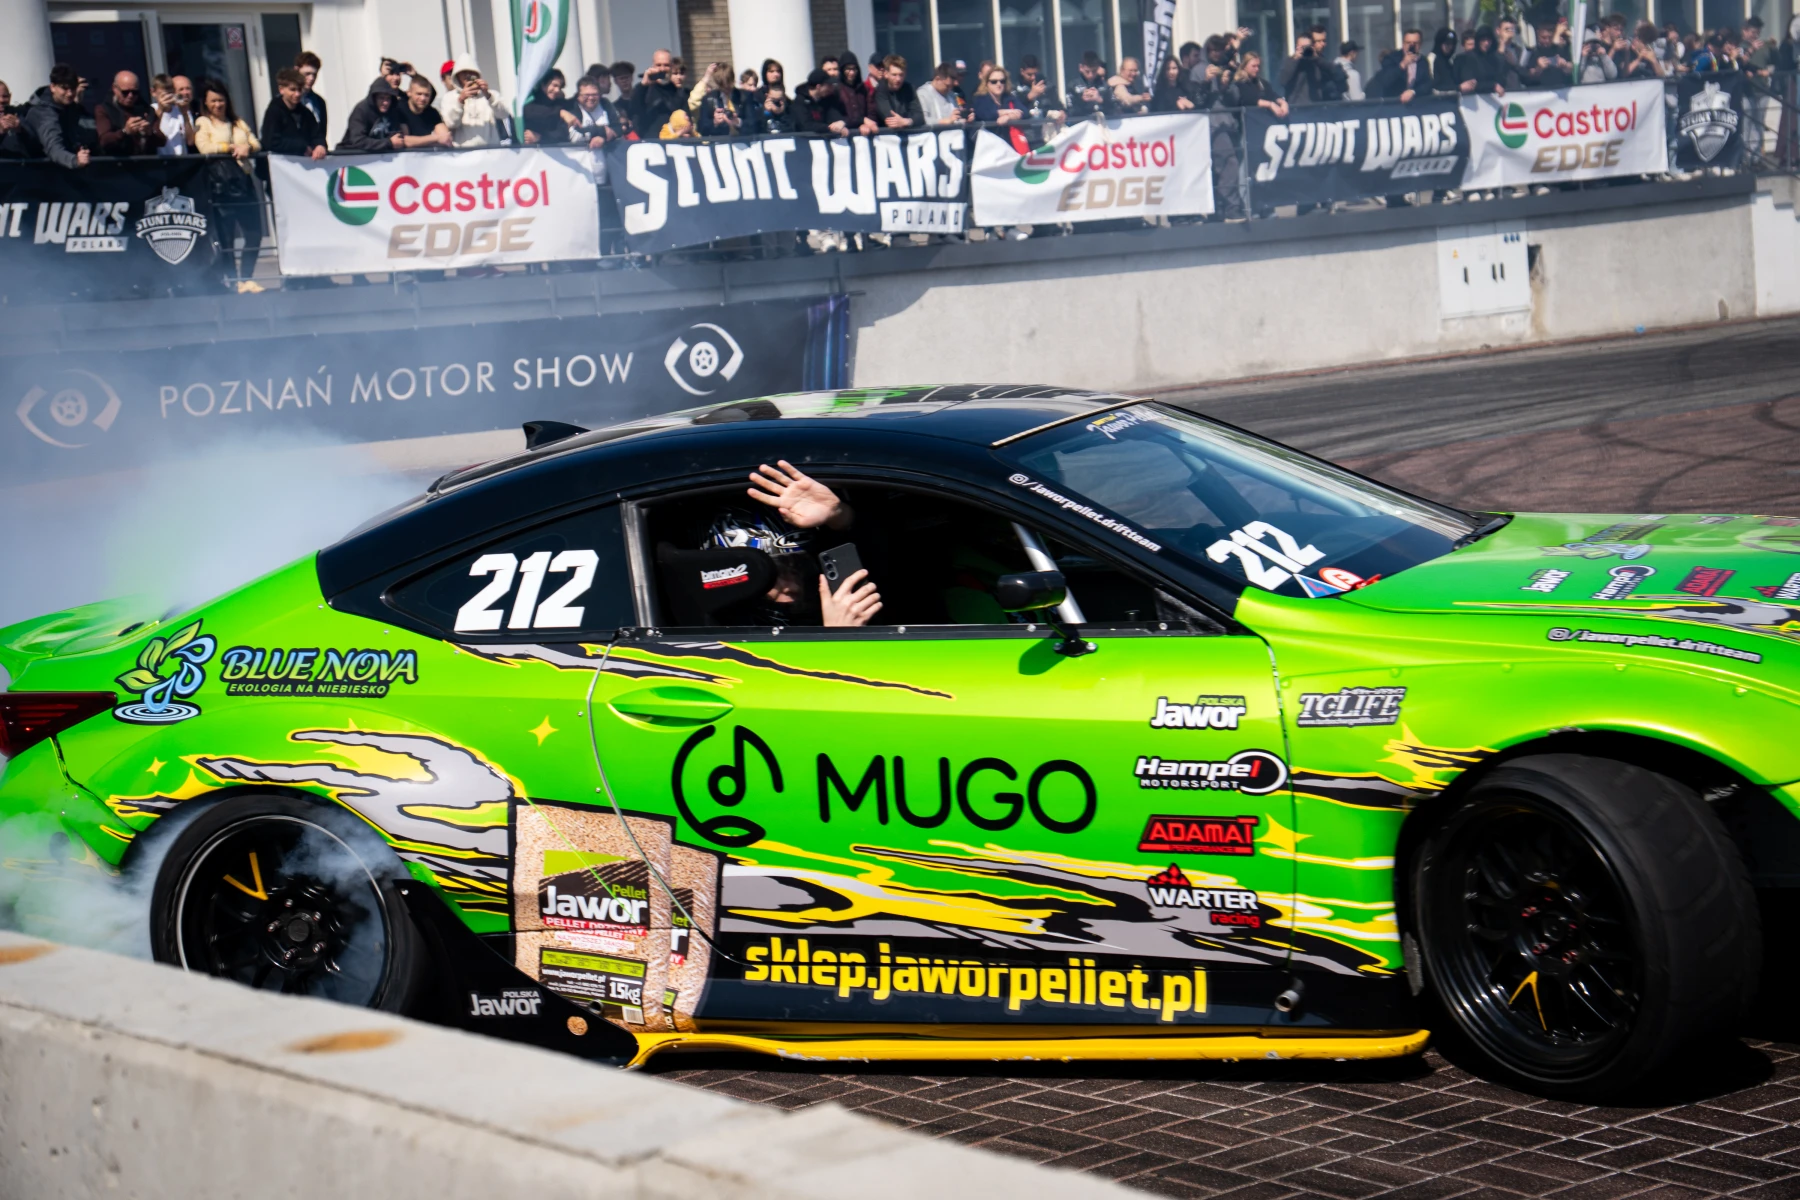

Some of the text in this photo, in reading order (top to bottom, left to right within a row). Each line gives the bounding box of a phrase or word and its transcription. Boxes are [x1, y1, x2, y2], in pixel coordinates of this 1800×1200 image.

[1534, 100, 1637, 139] Castrol
[1059, 135, 1175, 173] Castrol
[1255, 112, 1458, 182] STUNT WARS
[1531, 139, 1625, 173] EDGE
[389, 169, 549, 215] Castrol
[624, 129, 965, 235] STUNT WARS
[1056, 175, 1166, 212] EDGE
[34, 202, 129, 244] WARS
[135, 214, 207, 231] STUNT WARS
[891, 208, 961, 227] POLAND
[71, 239, 125, 249] POLAND
[387, 216, 536, 259] EDGE
[159, 352, 634, 418] POZNAŃ MOTOR SHOW
[1205, 520, 1326, 590] 212
[454, 549, 599, 632] 212
[222, 648, 417, 682] BLUE NOVA
[229, 683, 387, 695] EKOLOGIA NA NIEBIESKO
[1199, 697, 1245, 706] POLSKA
[1151, 698, 1246, 728] Jawor
[1135, 757, 1262, 781] Hampel
[1140, 778, 1240, 789] MOTORSPORT
[816, 752, 1098, 834] MUGO
[1149, 817, 1258, 844] ADAMAT
[542, 885, 648, 924] Jawor
[611, 884, 647, 900] Pellet
[1149, 887, 1259, 910] WARTER
[545, 916, 587, 930] PELLET
[1210, 911, 1260, 928] racing
[471, 994, 542, 1016] Jawor
[502, 990, 541, 999] POLSKA
[609, 981, 642, 1005] 15kg
